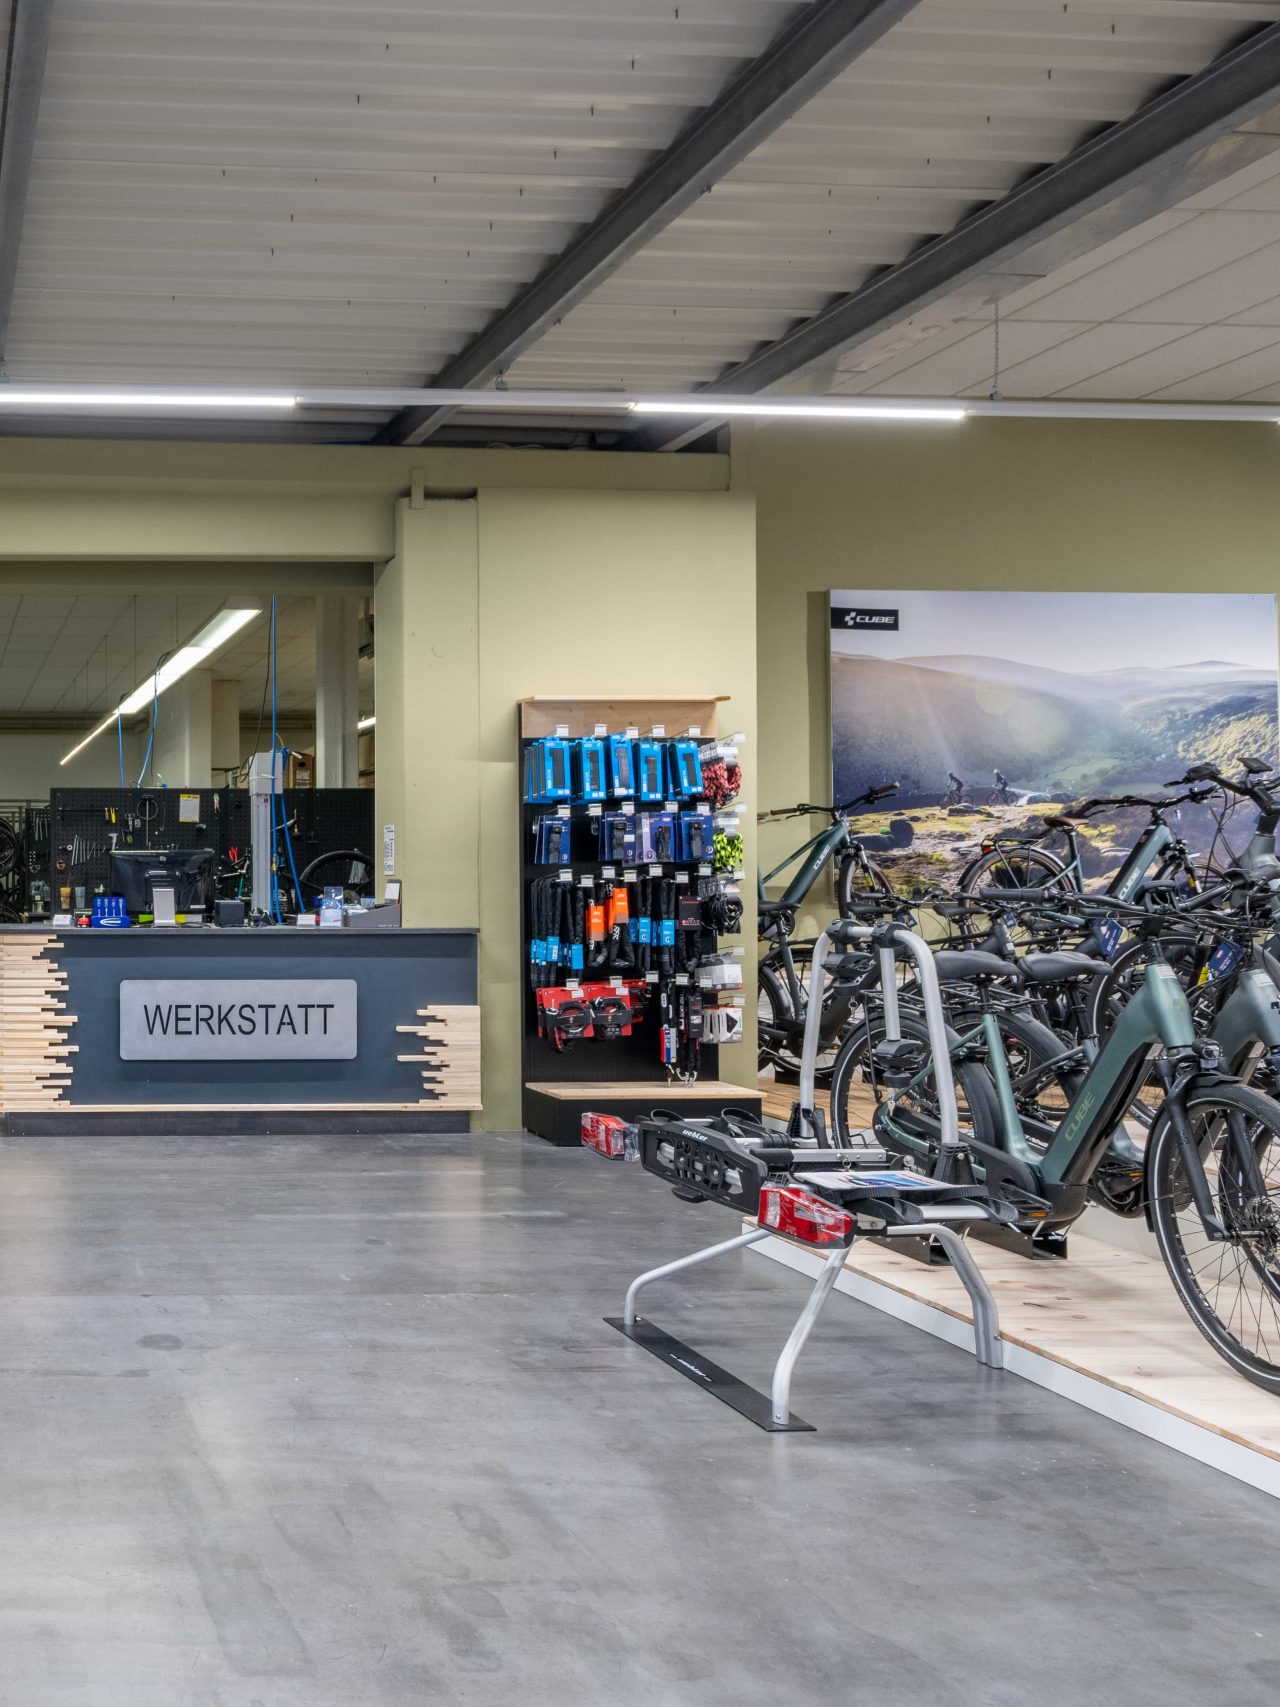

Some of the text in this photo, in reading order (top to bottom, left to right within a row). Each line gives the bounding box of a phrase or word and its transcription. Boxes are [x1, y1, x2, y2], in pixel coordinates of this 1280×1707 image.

[856, 615, 895, 624] CUBE
[813, 844, 831, 870] CUBE
[1118, 866, 1141, 900] CUBE
[144, 1004, 335, 1036] WERKSTATT
[1064, 1091, 1095, 1142] CUBE
[682, 1129, 708, 1141] uebler
